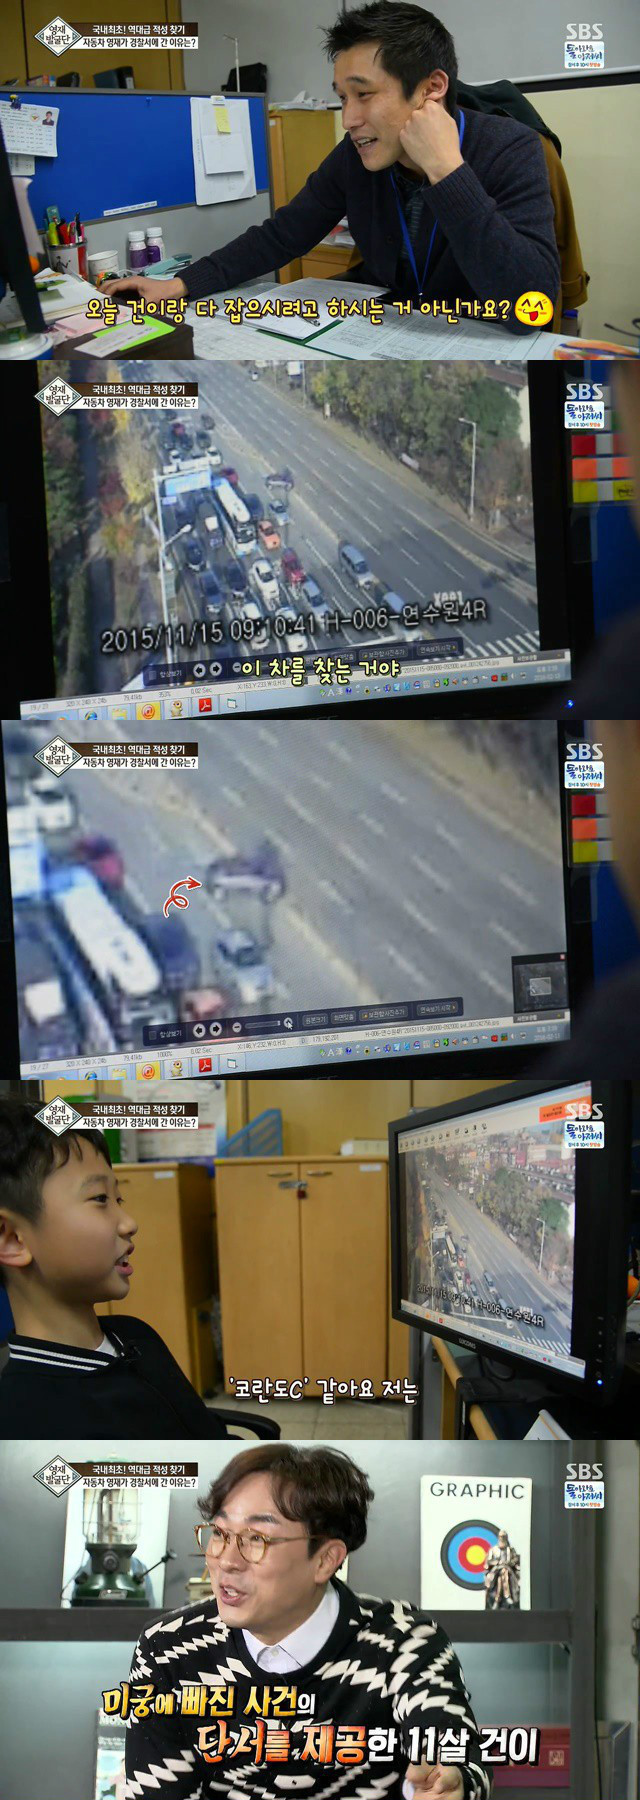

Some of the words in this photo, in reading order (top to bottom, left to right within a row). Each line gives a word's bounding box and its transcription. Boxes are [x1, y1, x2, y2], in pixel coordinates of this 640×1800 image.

[101, 619, 223, 653] 2015/11/15
[230, 608, 315, 640] 09:10:41
[430, 1482, 524, 1499] GRAPHIC
